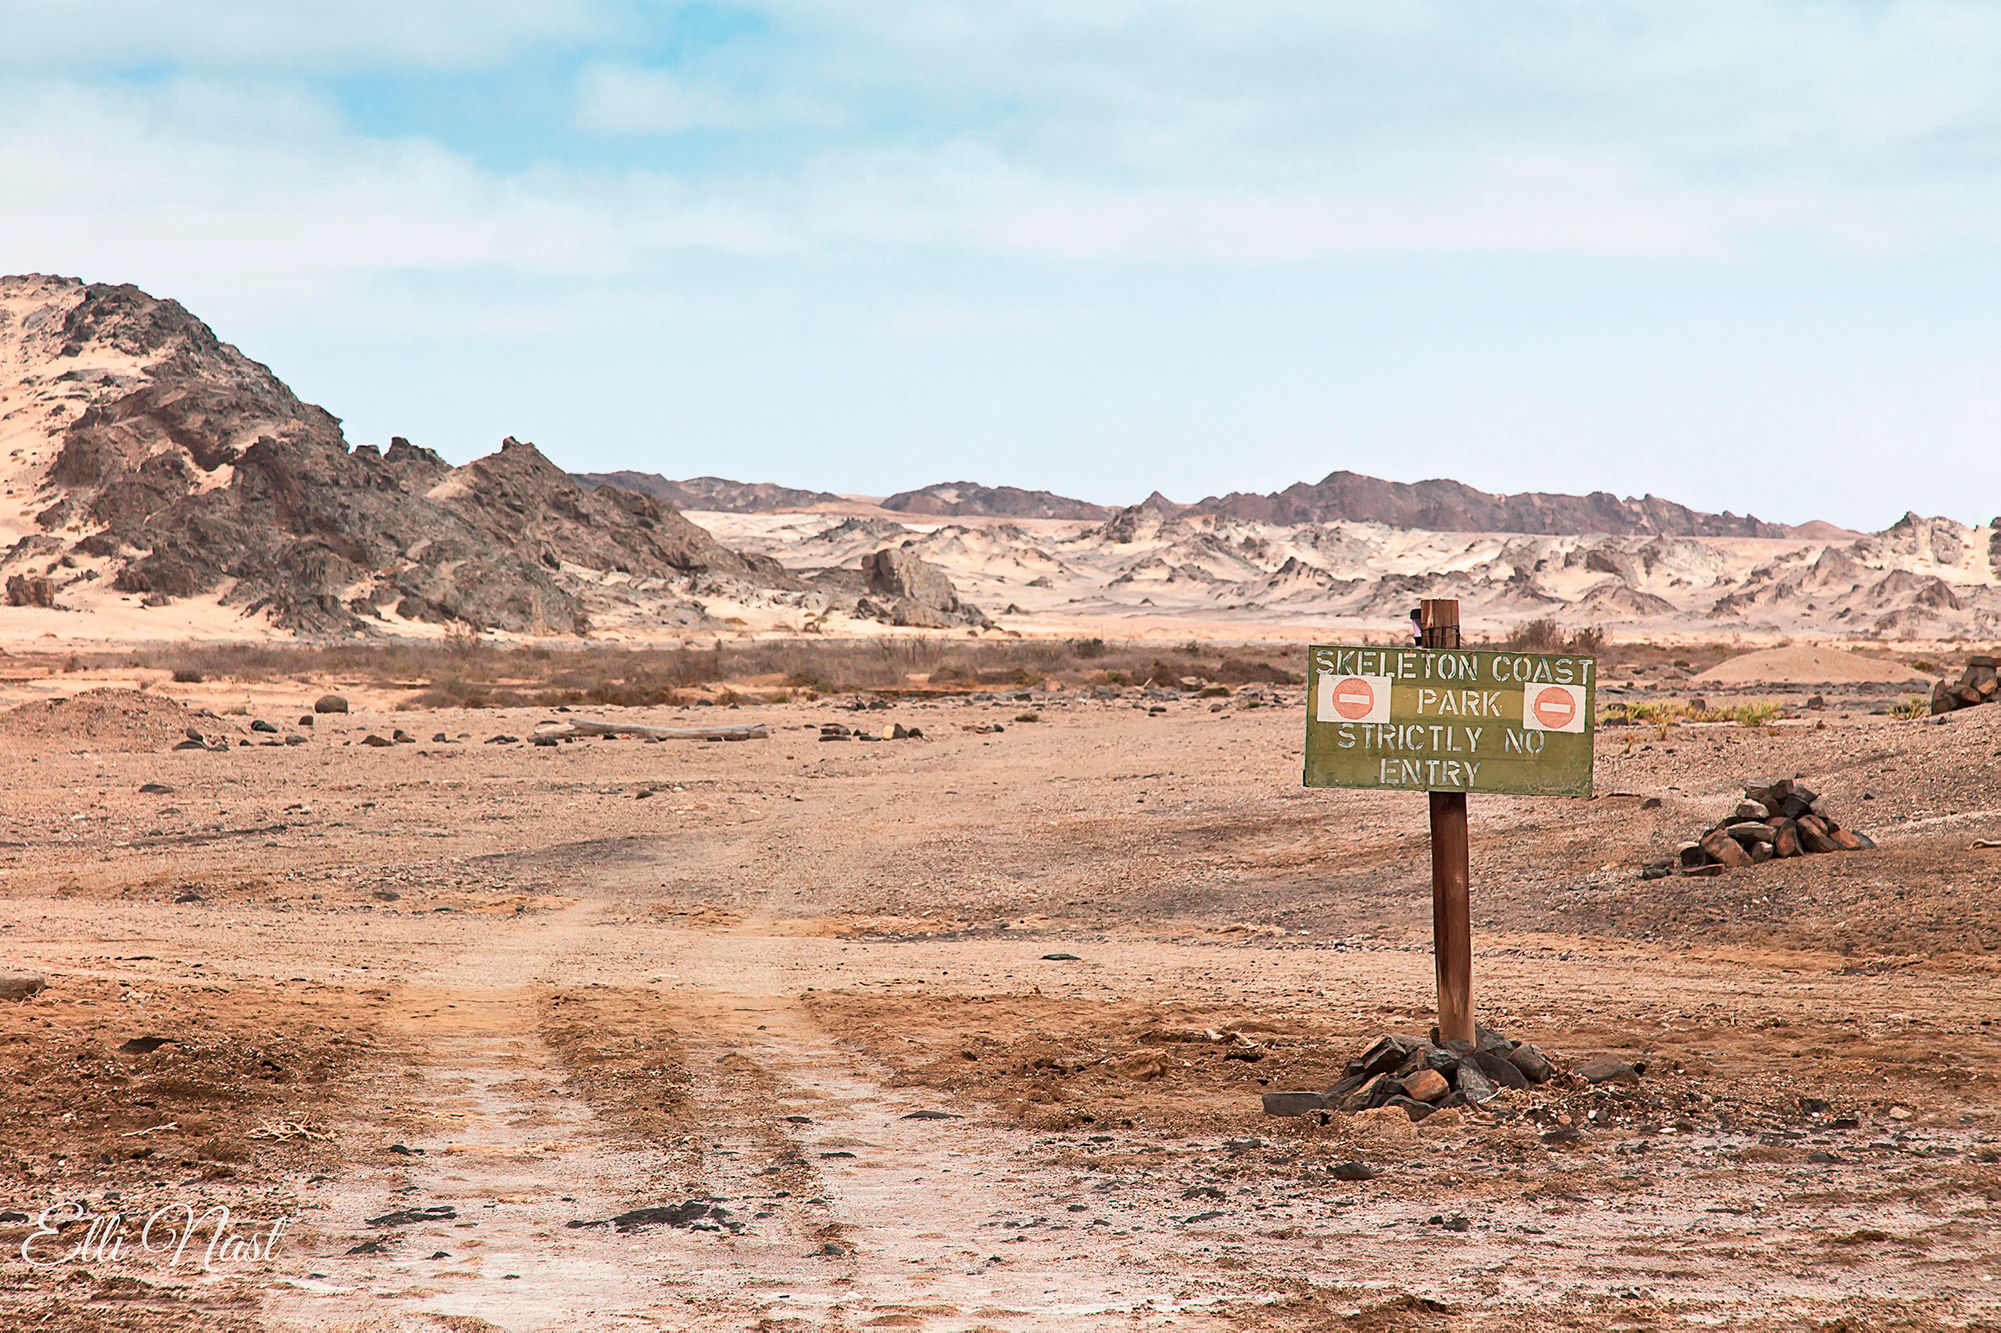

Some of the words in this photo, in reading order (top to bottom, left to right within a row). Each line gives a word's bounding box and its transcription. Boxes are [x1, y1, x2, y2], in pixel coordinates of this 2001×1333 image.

[1316, 650, 1478, 681] SKELETON
[1492, 655, 1593, 685] COAST
[1417, 689, 1501, 717] PARK
[1338, 723, 1483, 753] STRICTLY
[1505, 728, 1545, 753] NO
[1380, 758, 1480, 787] ENTRY
